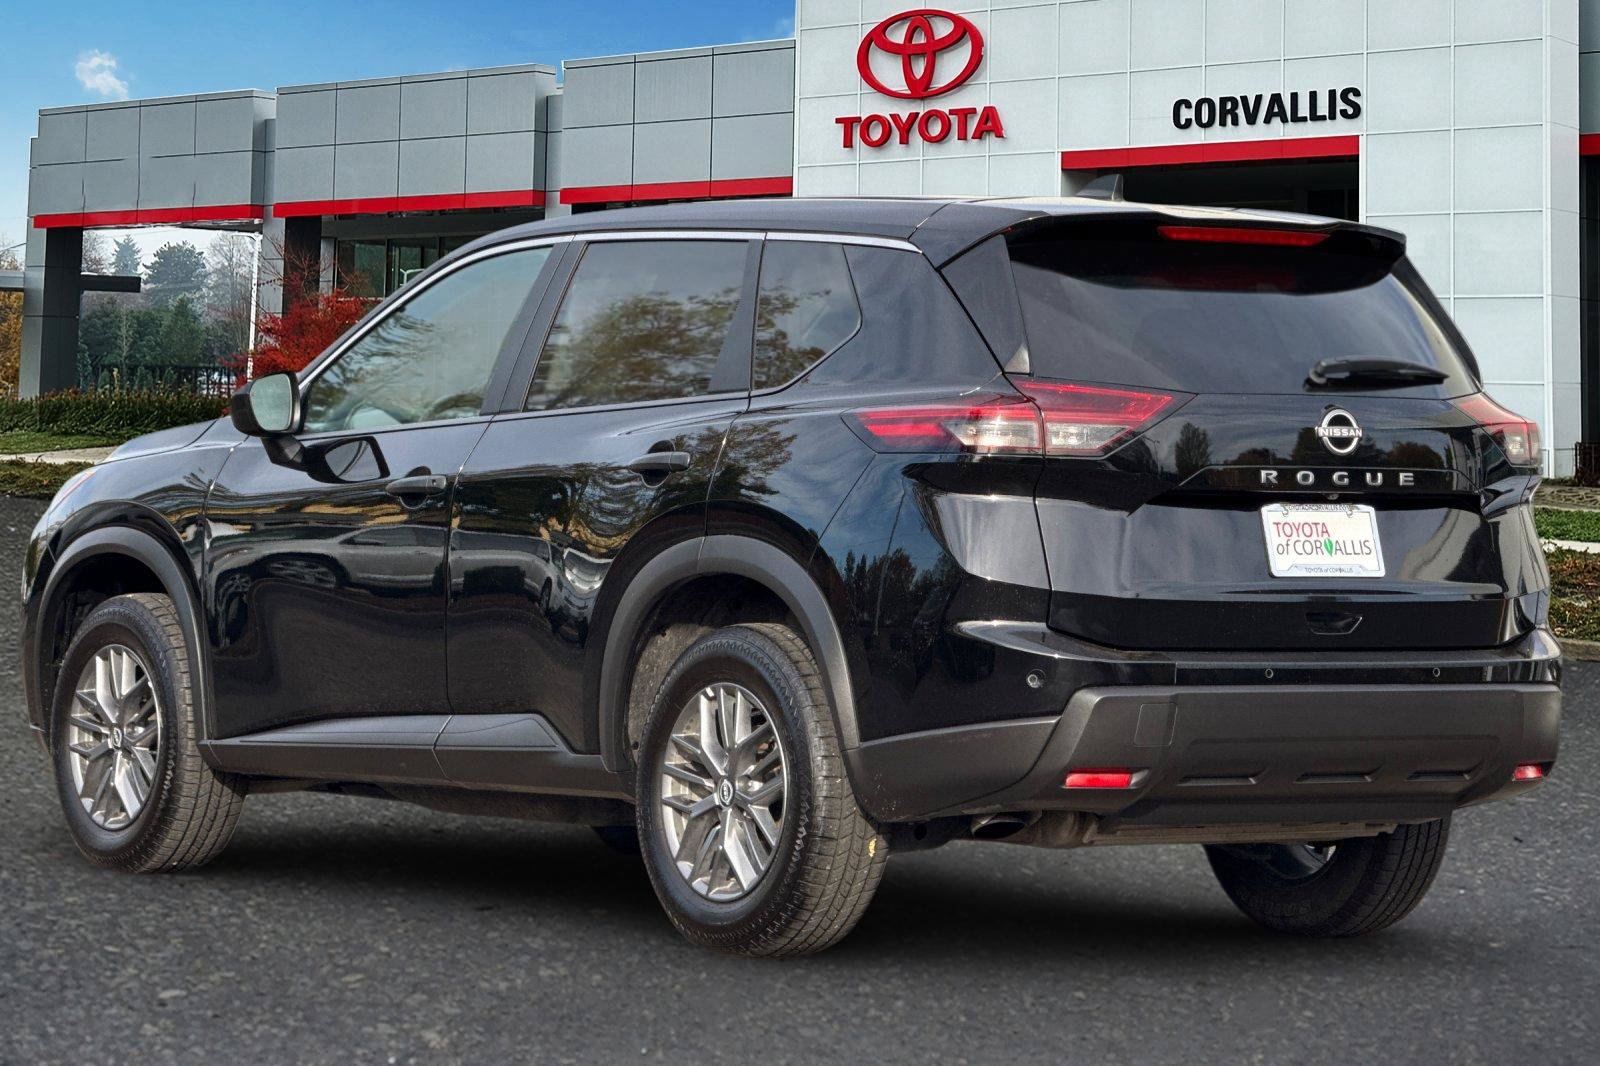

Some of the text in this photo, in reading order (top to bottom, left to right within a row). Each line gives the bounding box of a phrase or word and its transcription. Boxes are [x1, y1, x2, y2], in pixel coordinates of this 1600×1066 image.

[1172, 86, 1362, 130] CORVALLIS
[835, 105, 1006, 149] TOYOTA
[1317, 427, 1363, 438] NISSAN
[1260, 469, 1415, 486] ROGUE
[1273, 521, 1331, 538] TOYOTA
[1276, 538, 1373, 557] of CORVALLIS
